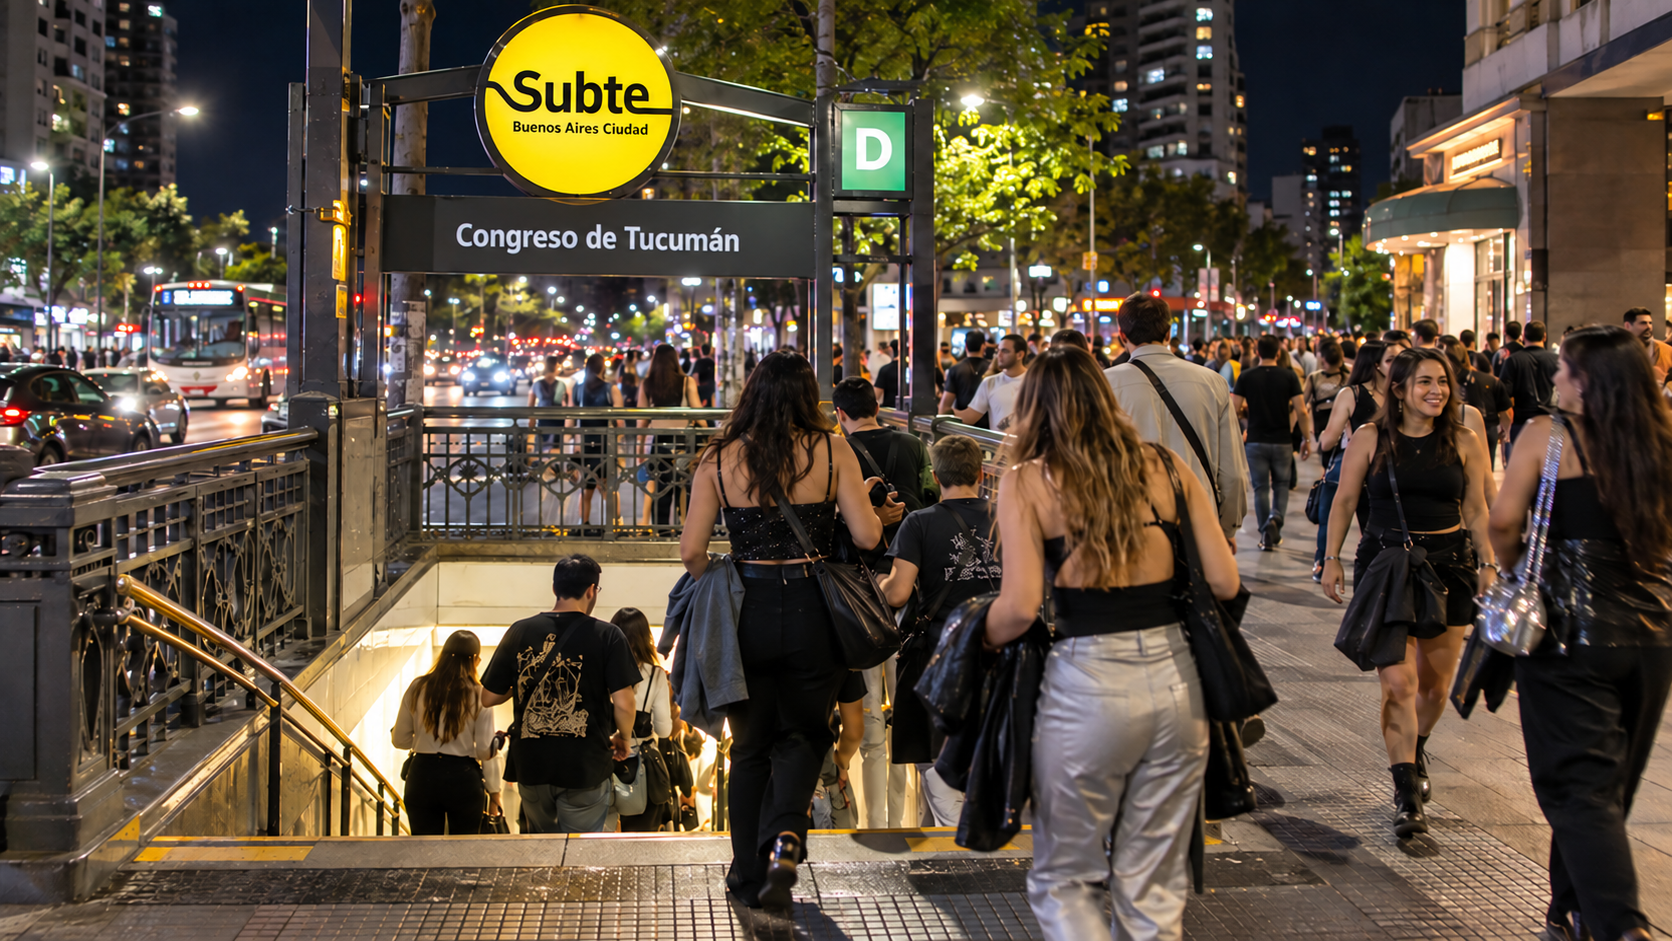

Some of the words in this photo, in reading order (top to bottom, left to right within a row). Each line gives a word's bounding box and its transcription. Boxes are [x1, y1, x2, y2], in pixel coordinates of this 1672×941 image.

[512, 70, 650, 115] Subte
[512, 121, 562, 134] Buenos
[565, 121, 599, 135] Aires
[602, 122, 649, 136] Ciudad
[855, 127, 893, 171] D
[456, 222, 578, 254] Congreso
[585, 223, 617, 250] de
[623, 225, 740, 252] Tucumán
